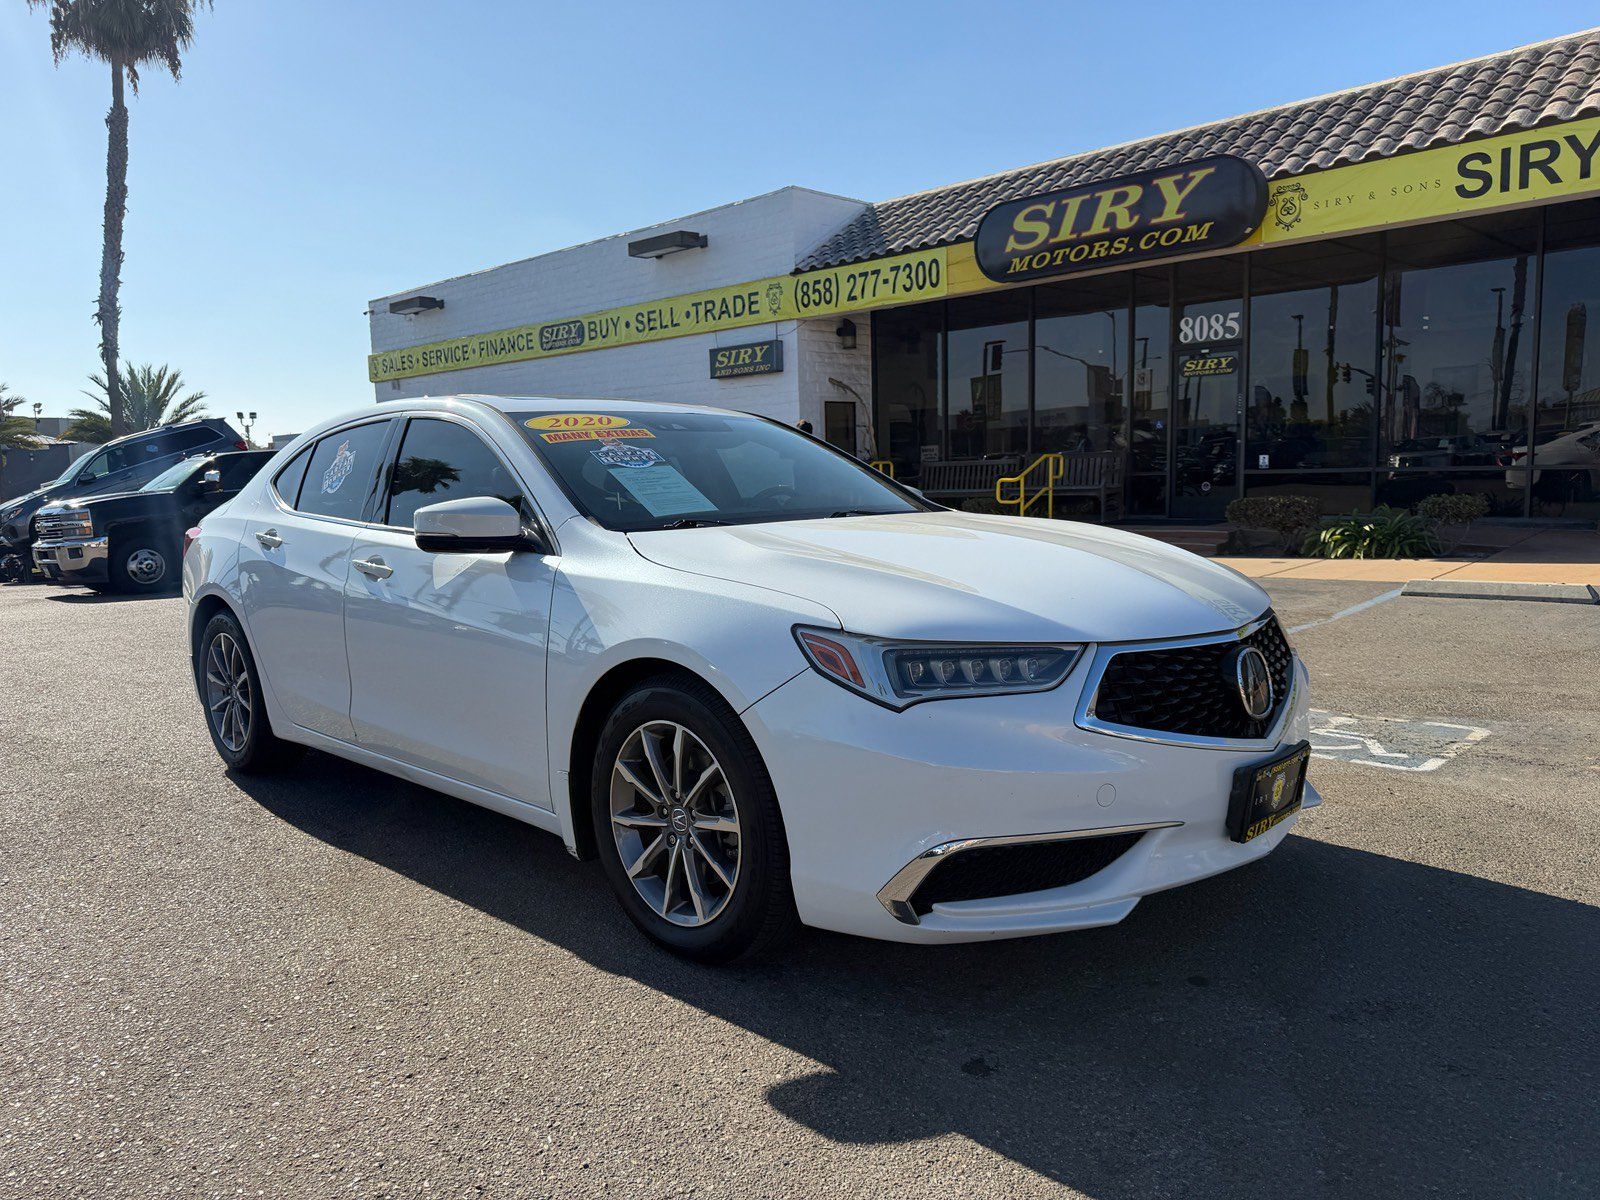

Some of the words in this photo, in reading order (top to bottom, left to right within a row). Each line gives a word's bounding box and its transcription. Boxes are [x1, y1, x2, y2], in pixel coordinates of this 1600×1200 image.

[1454, 128, 1600, 199] SIRY
[1005, 166, 1216, 253] SIRY
[1313, 194, 1356, 211] SIRY
[1367, 190, 1376, 200] &
[1390, 179, 1442, 197] SONS
[1007, 221, 1215, 274] MOTORS.COM
[794, 273, 840, 313] (858)
[847, 259, 940, 301] 277-7300
[542, 321, 581, 342] SIRY
[588, 315, 621, 341] BUY
[635, 307, 680, 334] SELL
[691, 291, 760, 324] TRADE
[1179, 312, 1240, 343] 8085
[381, 353, 415, 375] SALES
[422, 342, 470, 368] SERVICE
[479, 331, 534, 359] FINANCE
[715, 345, 769, 368] SIRY
[1184, 357, 1233, 371] SIRY
[716, 368, 732, 377] AND
[732, 366, 754, 376] SONS
[755, 363, 771, 372] INC
[546, 431, 592, 442] MANY
[595, 429, 649, 439] EXTRAS
[547, 415, 613, 429] 2020
[1246, 815, 1276, 842] SIRY
